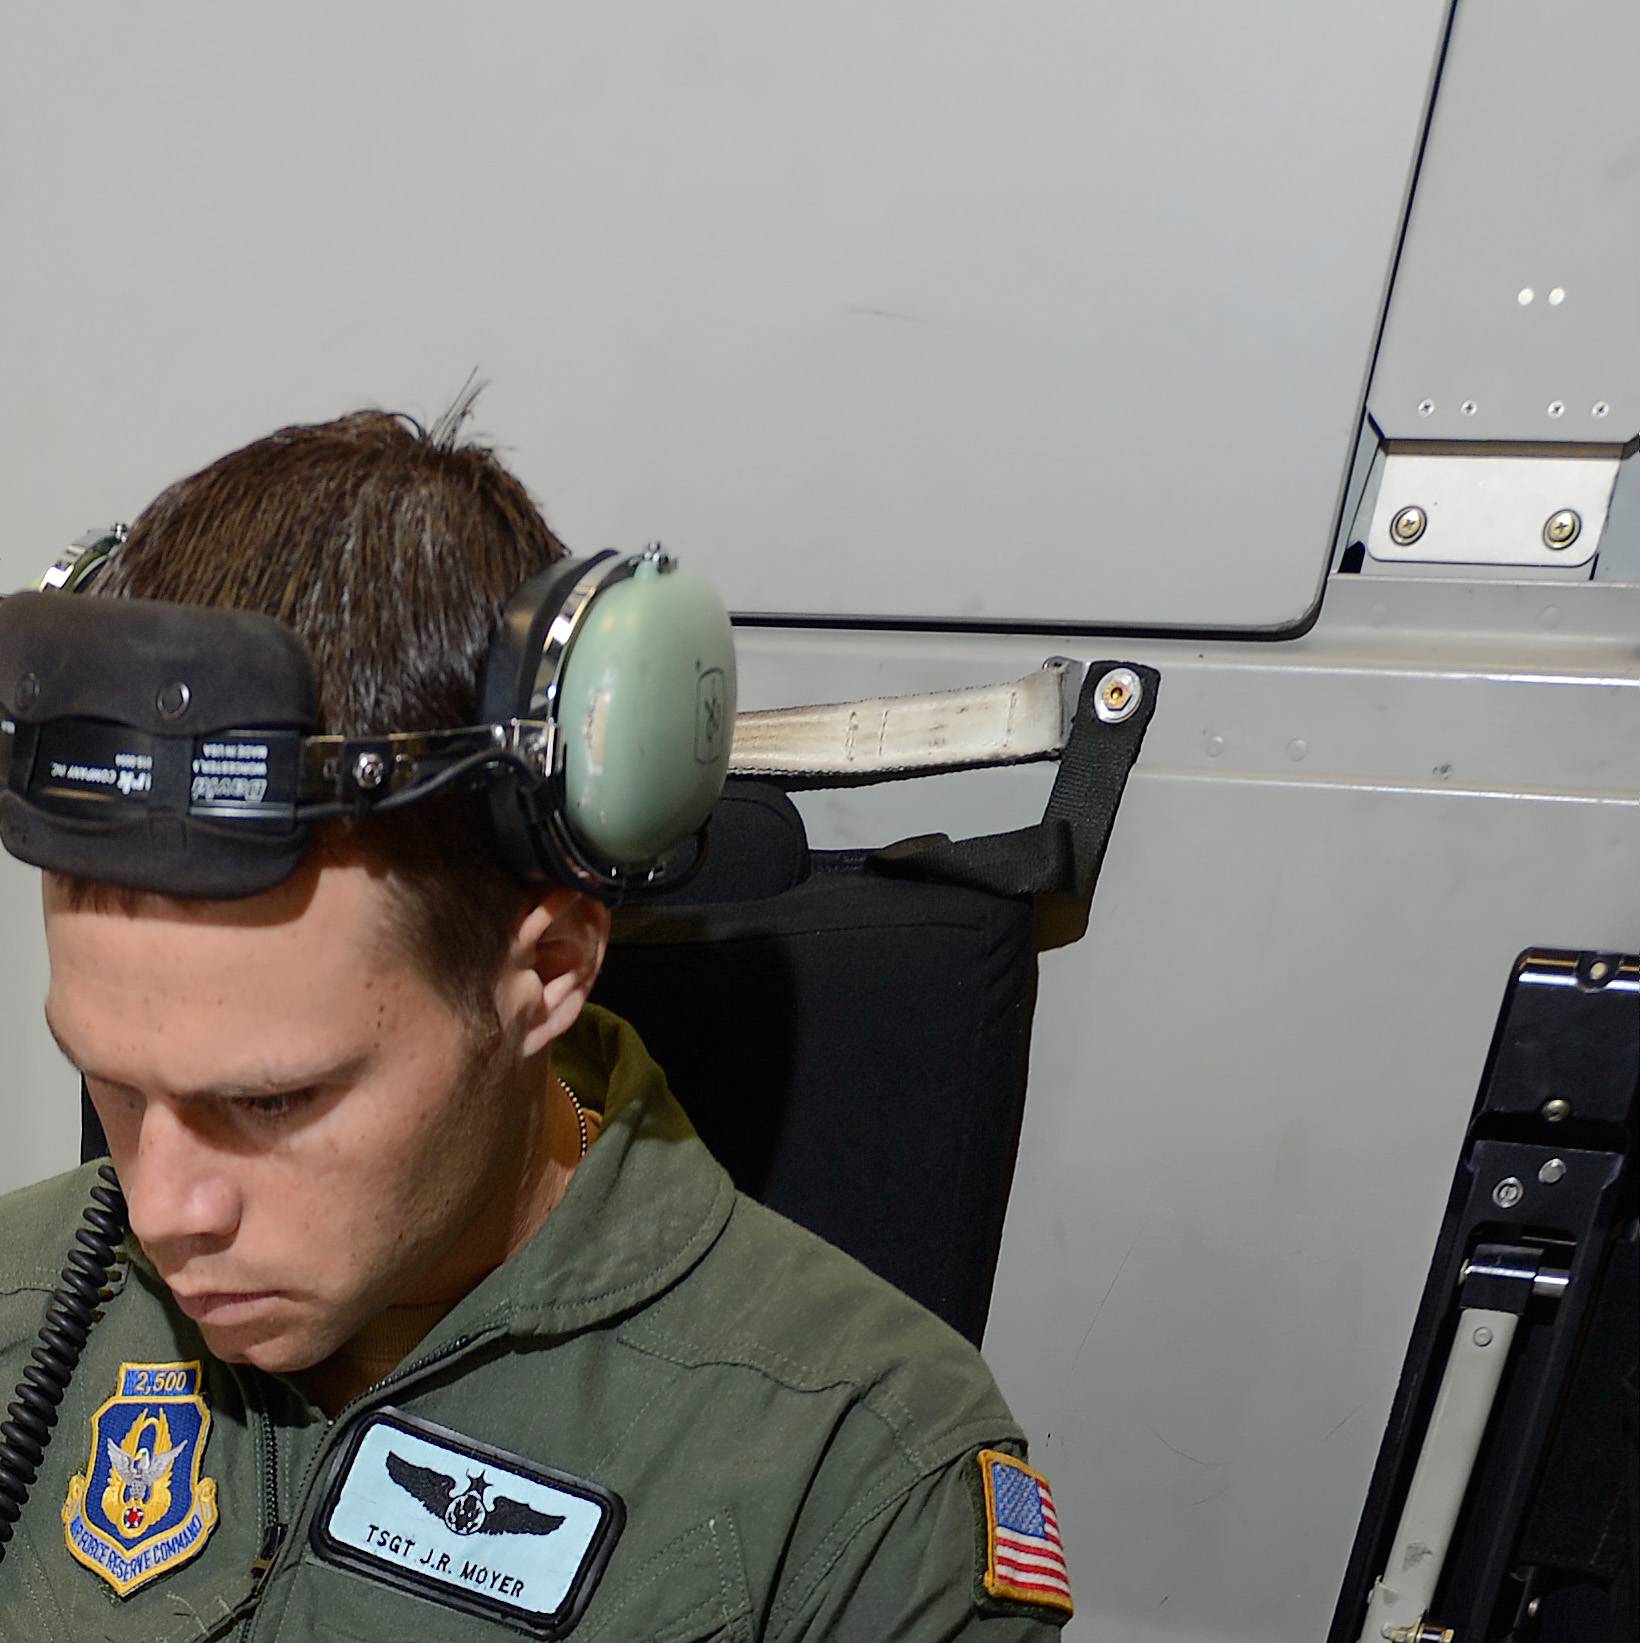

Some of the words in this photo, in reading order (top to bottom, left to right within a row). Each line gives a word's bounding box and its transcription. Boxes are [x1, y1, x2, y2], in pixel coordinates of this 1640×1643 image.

[134, 1371, 187, 1396] 2,500
[77, 1531, 109, 1563] FORCE
[106, 1549, 151, 1583] RESERVE
[153, 1513, 203, 1565] COMMAND
[366, 1524, 416, 1557] TSGT
[419, 1548, 452, 1575] J.R.
[460, 1560, 525, 1598] MOYER
